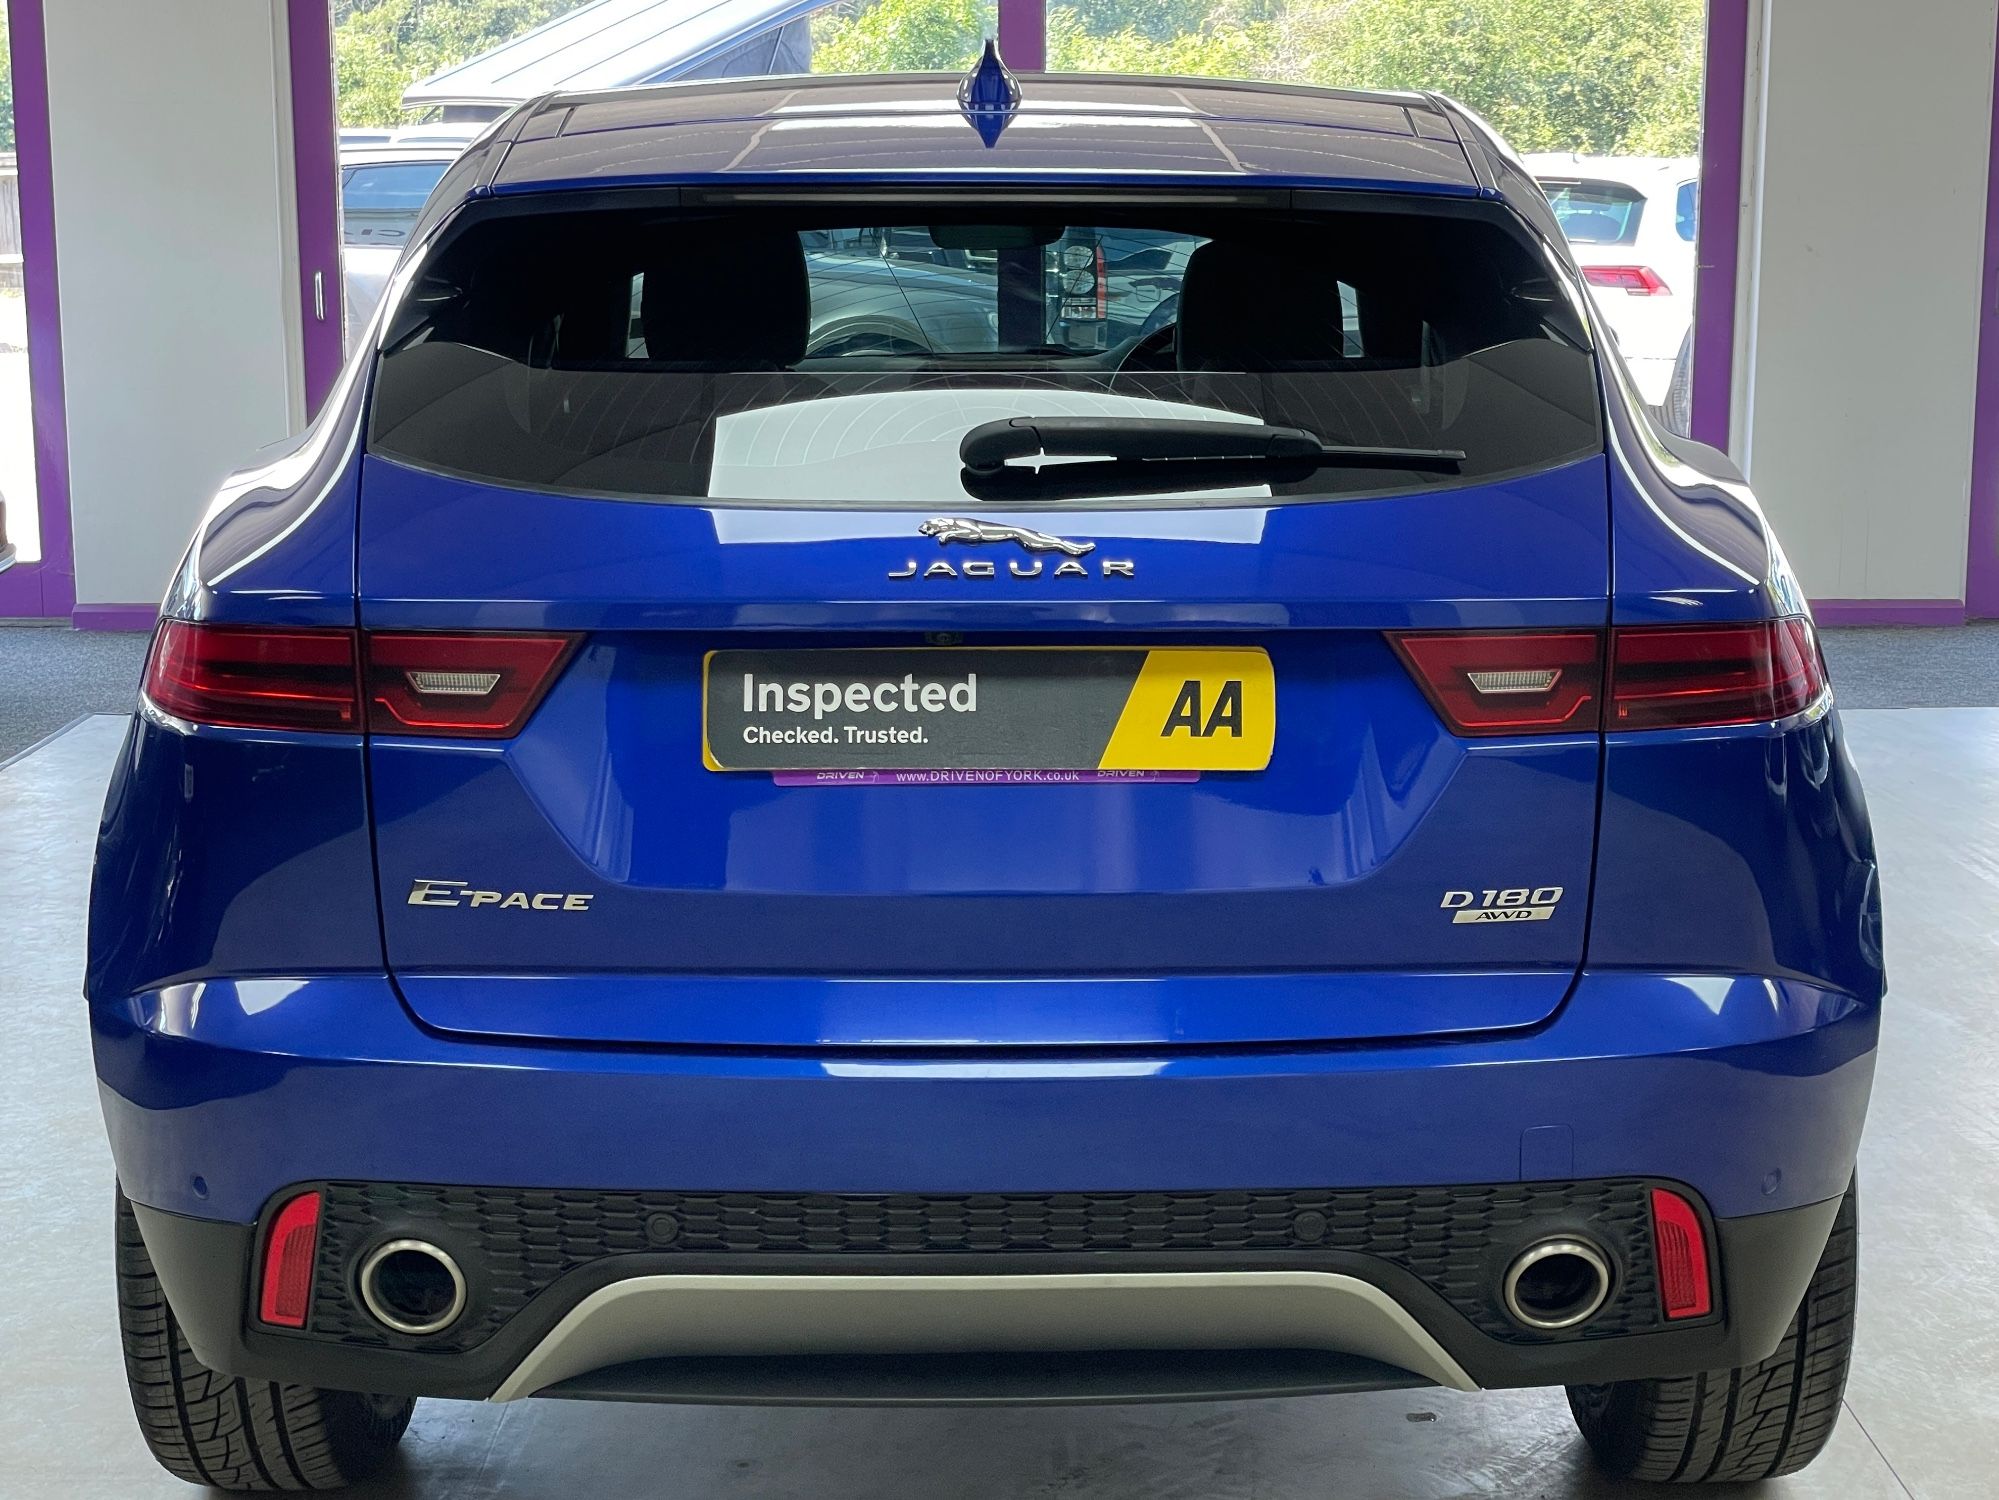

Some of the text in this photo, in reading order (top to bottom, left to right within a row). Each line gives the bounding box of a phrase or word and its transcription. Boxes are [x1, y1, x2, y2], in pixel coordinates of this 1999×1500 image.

[888, 561, 1135, 578] JAGUAR
[743, 673, 977, 720] Inspected
[1160, 680, 1243, 738] AA
[743, 726, 929, 744] Checked. Trusted.
[816, 771, 865, 780] DRIVEN
[896, 770, 1080, 781] www.DRIVENOFYORK.co.uk
[1097, 769, 1145, 777] DRIVEN
[408, 879, 594, 911] E-PACE
[1475, 910, 1532, 921] AWD
